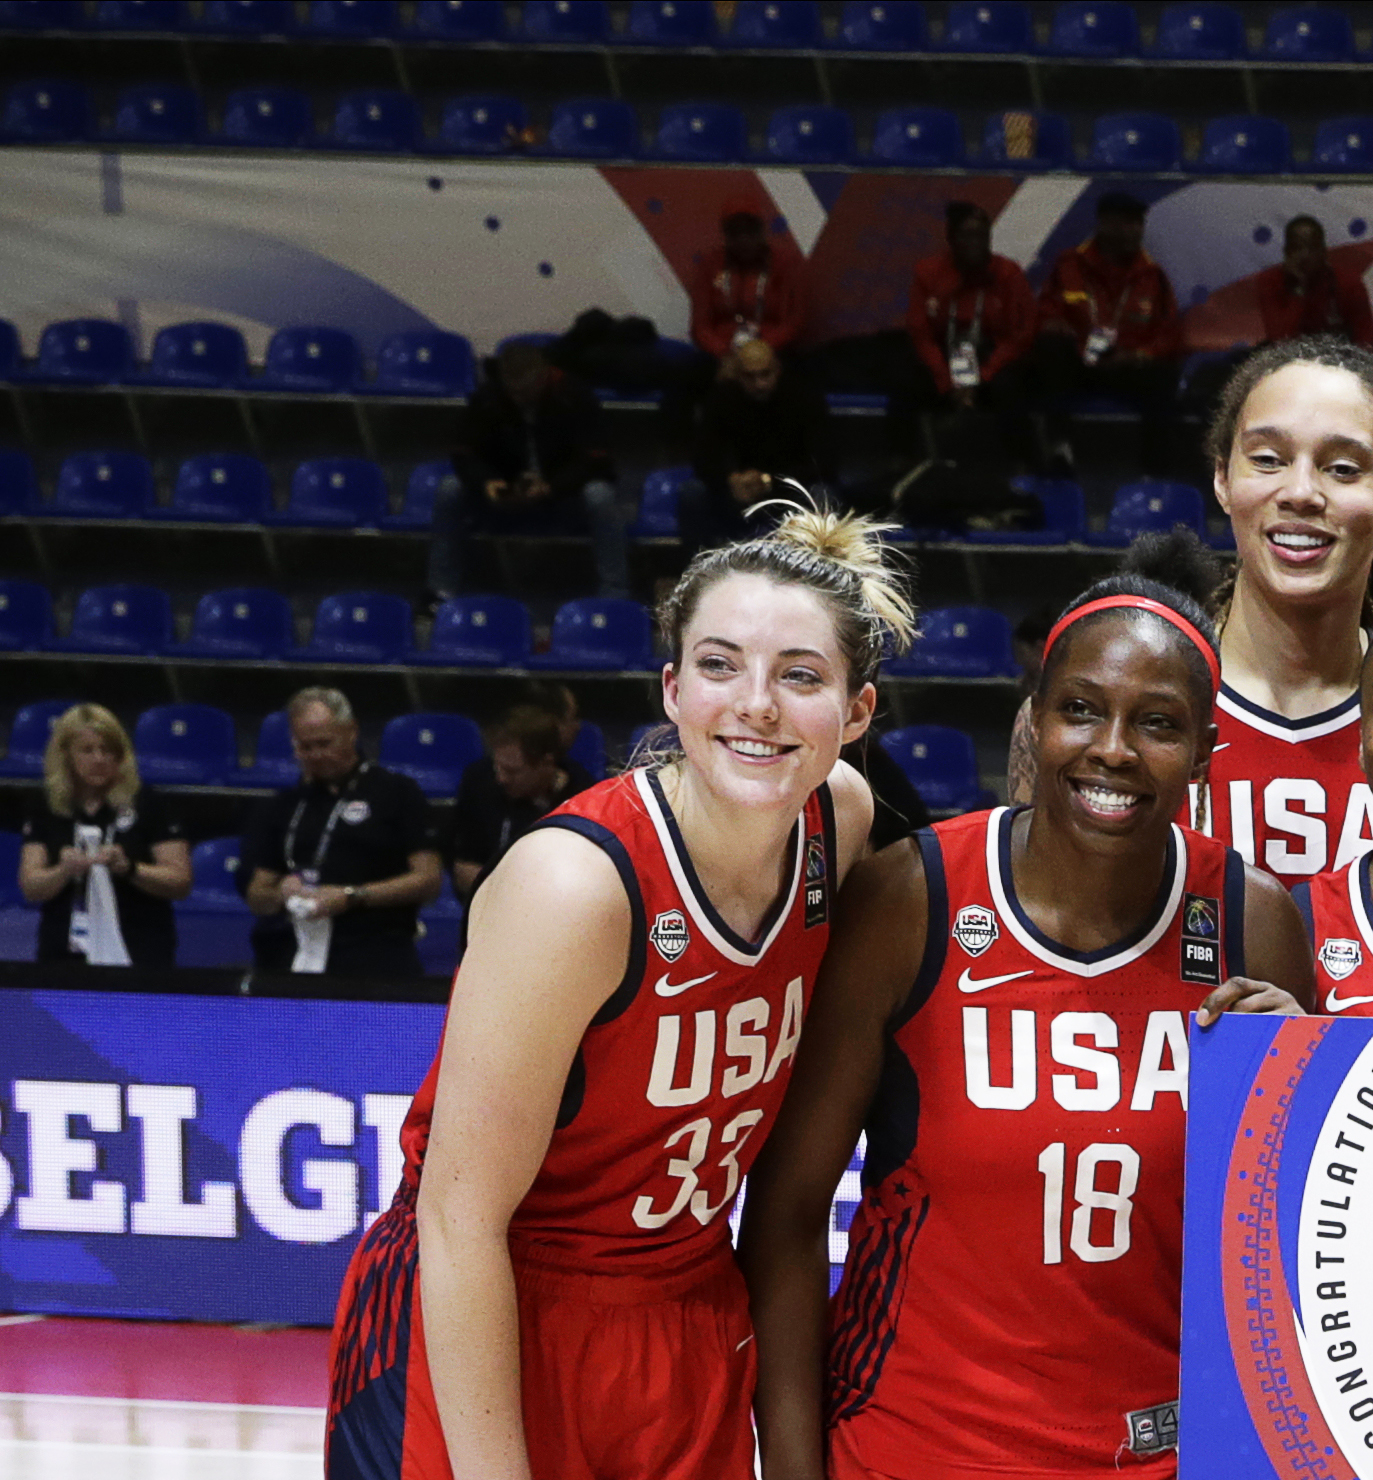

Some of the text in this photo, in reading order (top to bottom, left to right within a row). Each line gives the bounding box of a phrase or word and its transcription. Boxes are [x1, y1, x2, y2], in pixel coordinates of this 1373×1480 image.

[662, 919, 683, 931] USA
[962, 914, 988, 927] USA
[1186, 944, 1214, 962] FIBA
[646, 975, 803, 1107] USA
[962, 1006, 1190, 1112] USA
[631, 1109, 764, 1229] 33
[1038, 1142, 1141, 1265] 18
